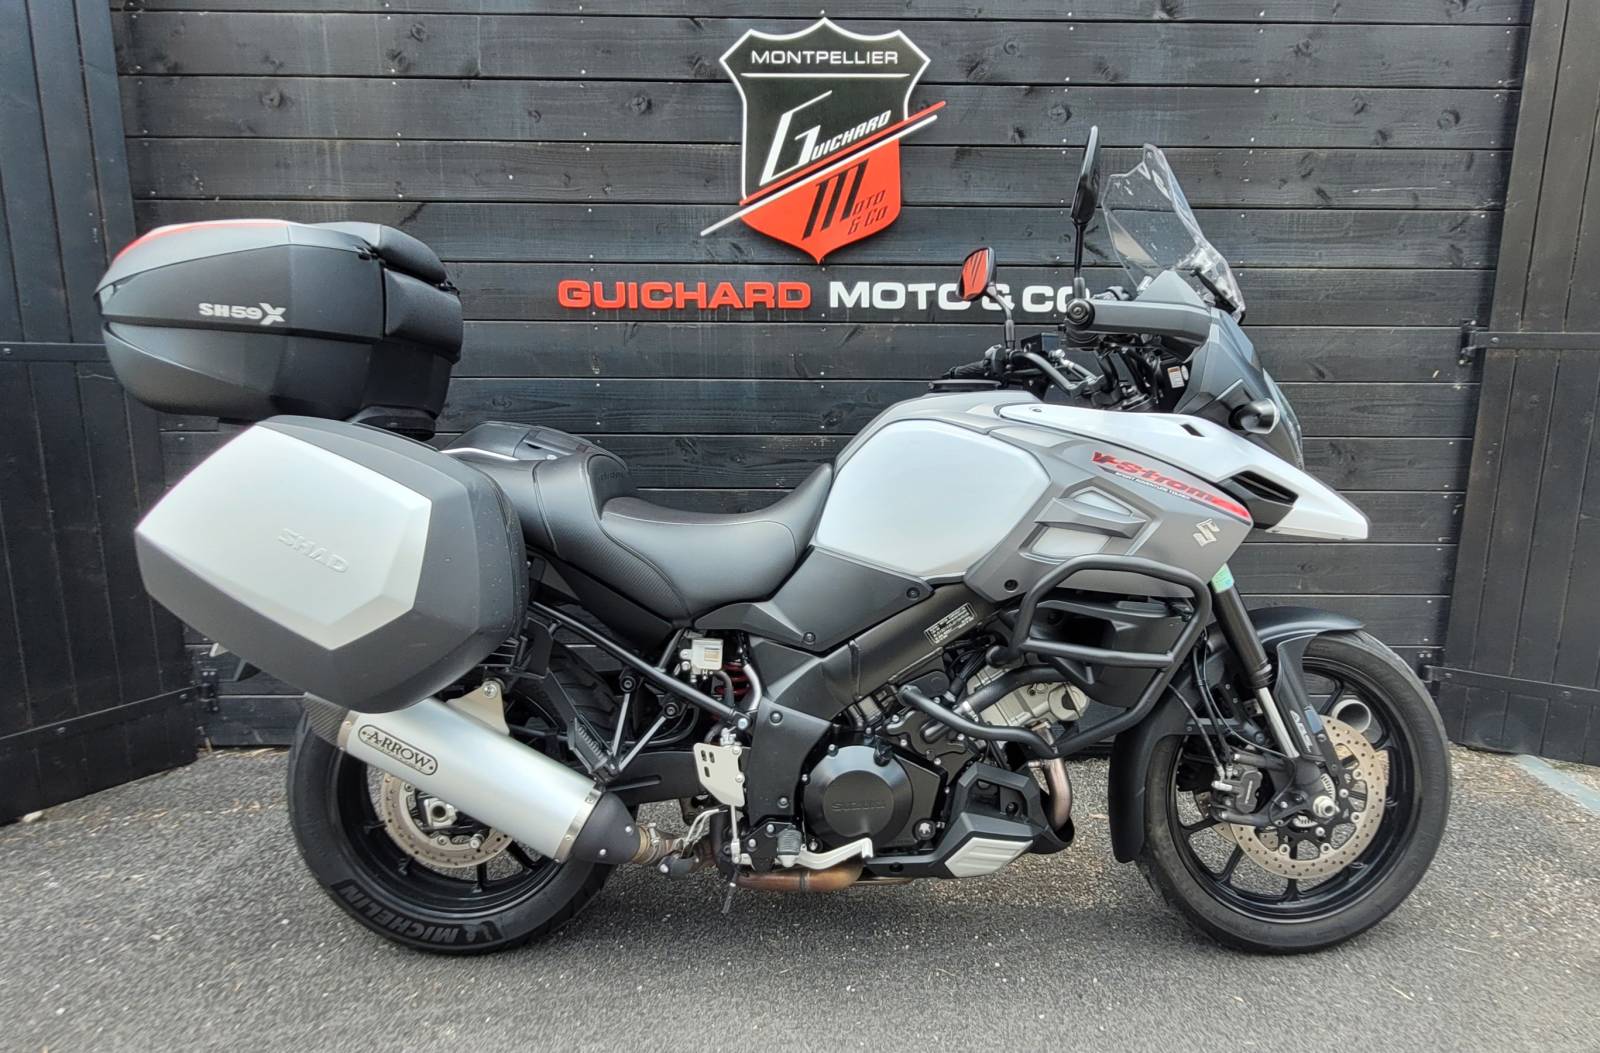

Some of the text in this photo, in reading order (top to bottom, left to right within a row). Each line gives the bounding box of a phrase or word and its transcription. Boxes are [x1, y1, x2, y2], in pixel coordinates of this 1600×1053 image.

[751, 50, 899, 65] MONTPELLIER
[759, 90, 891, 186] GUICHARD
[802, 159, 885, 240] MOTO
[557, 279, 812, 310] GUICHARD
[829, 281, 972, 311] MOTO
[276, 526, 350, 574] SHAD
[367, 730, 432, 768] ARROW
[338, 882, 460, 944] MICHELIN
